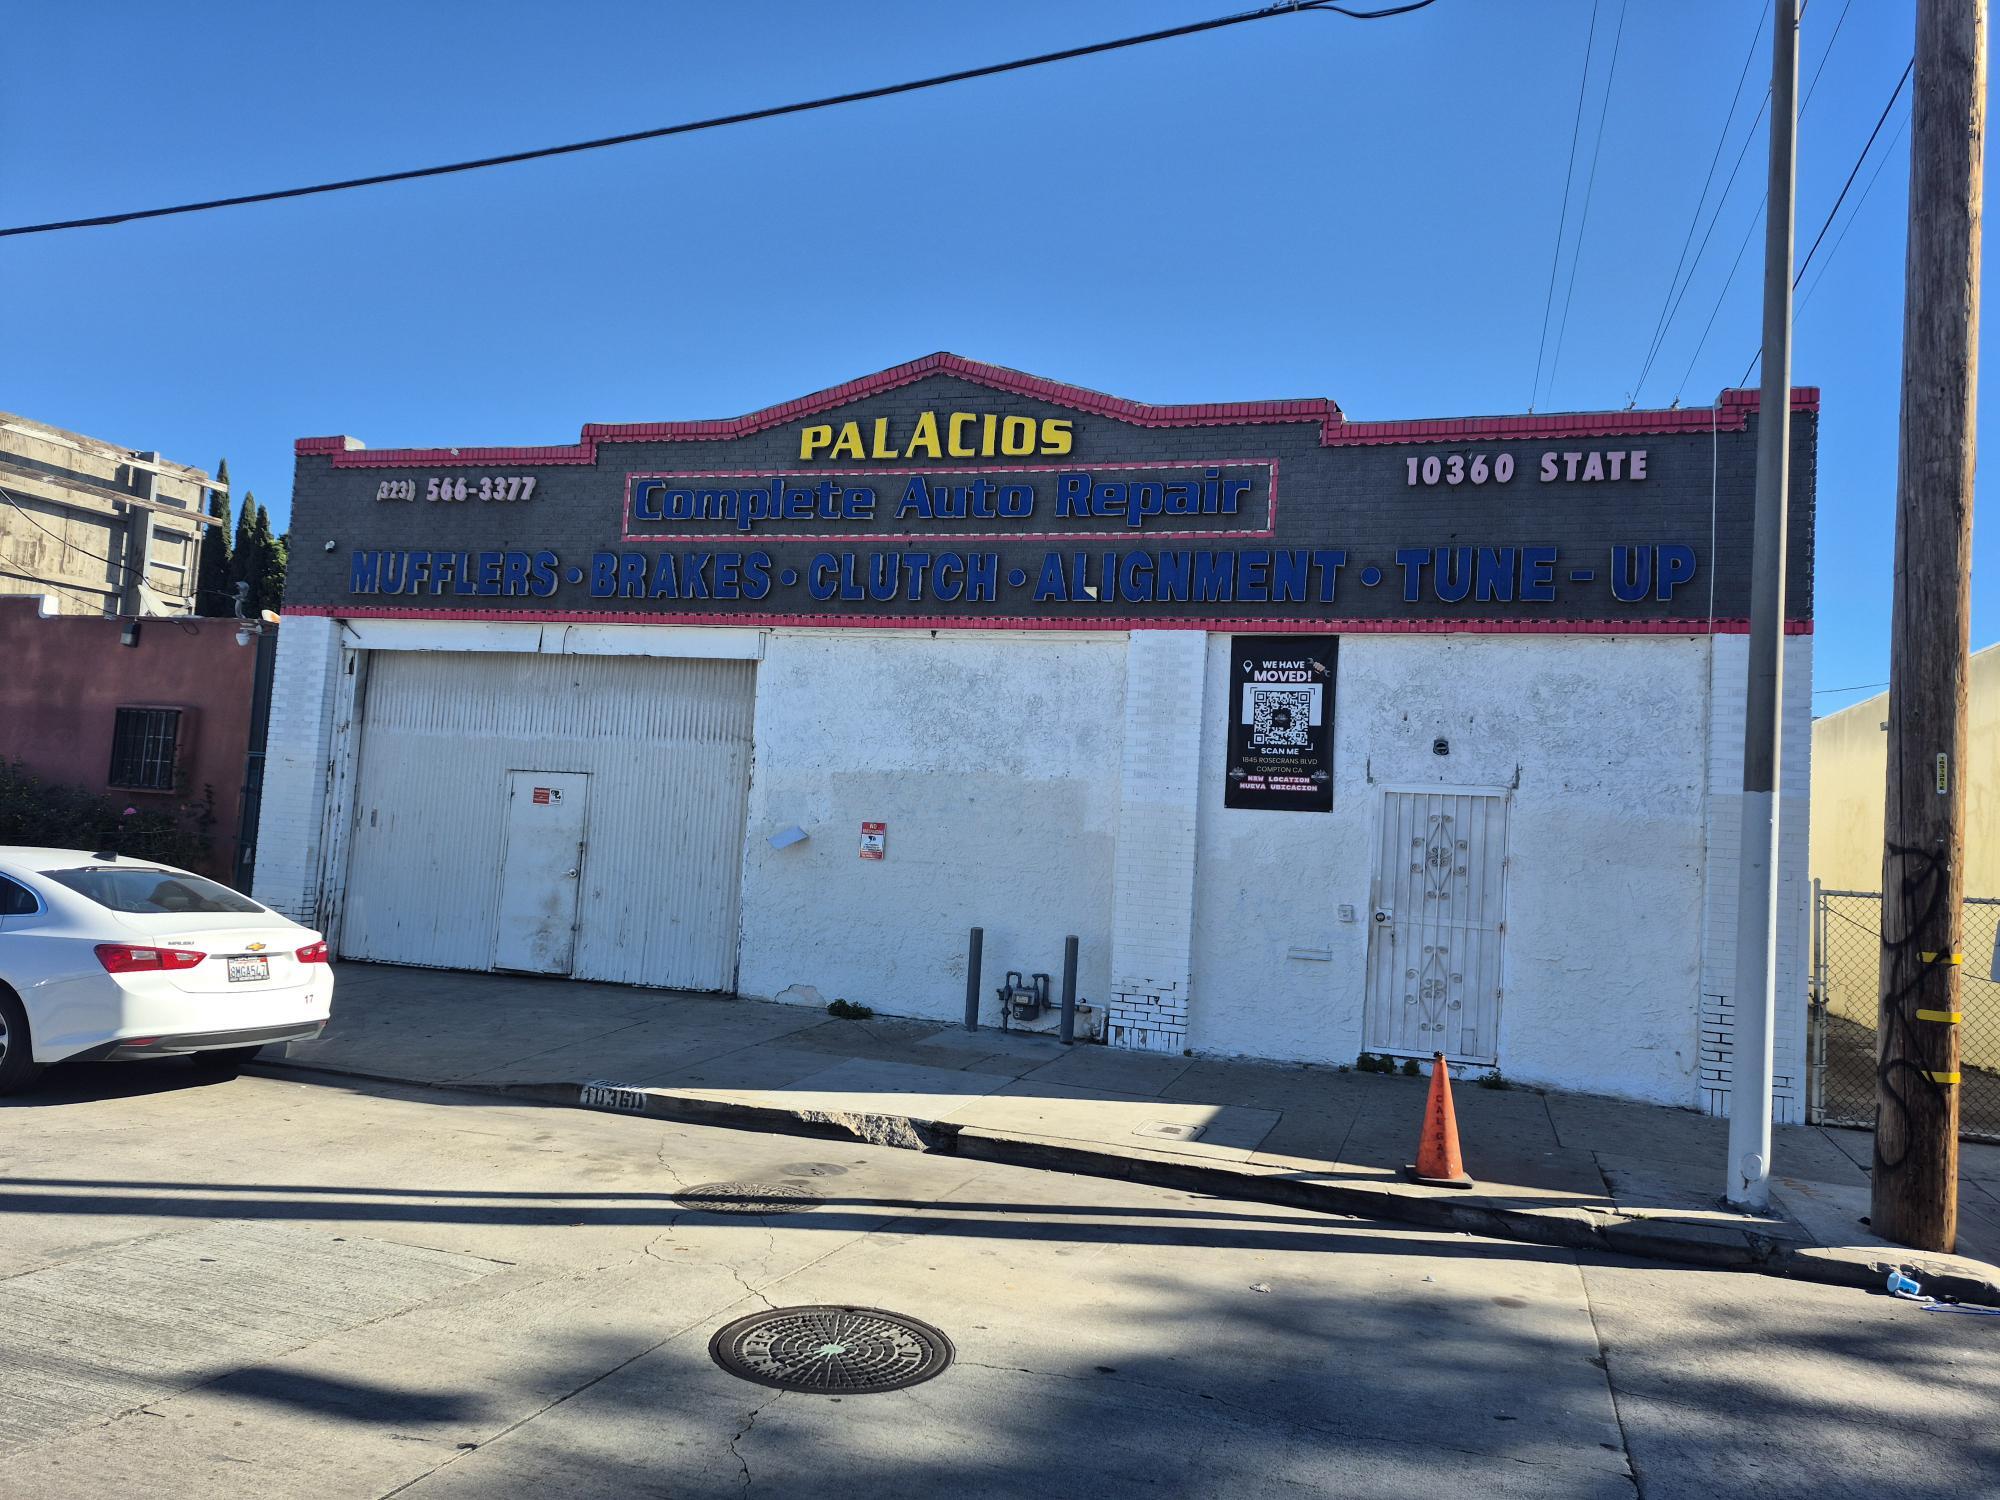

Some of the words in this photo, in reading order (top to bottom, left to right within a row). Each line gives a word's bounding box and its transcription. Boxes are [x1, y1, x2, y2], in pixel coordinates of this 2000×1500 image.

[799, 411, 1073, 459] PALACIOS
[1406, 453, 1515, 485] 10360
[1540, 450, 1647, 482] STATE
[376, 478, 416, 502] (323)
[426, 477, 537, 501] 566-3377
[634, 477, 877, 531] Complete
[895, 475, 1034, 519] Auto
[1055, 468, 1251, 527] Repair
[350, 550, 559, 598] MUFFLERS
[590, 551, 772, 600] BRAKES
[808, 551, 999, 602] CLUTCH
[1032, 550, 1347, 603] ALIGNMENT
[1254, 670, 1312, 682] MOVED!
[1262, 661, 1278, 669] WE
[1279, 661, 1305, 669] HAVE
